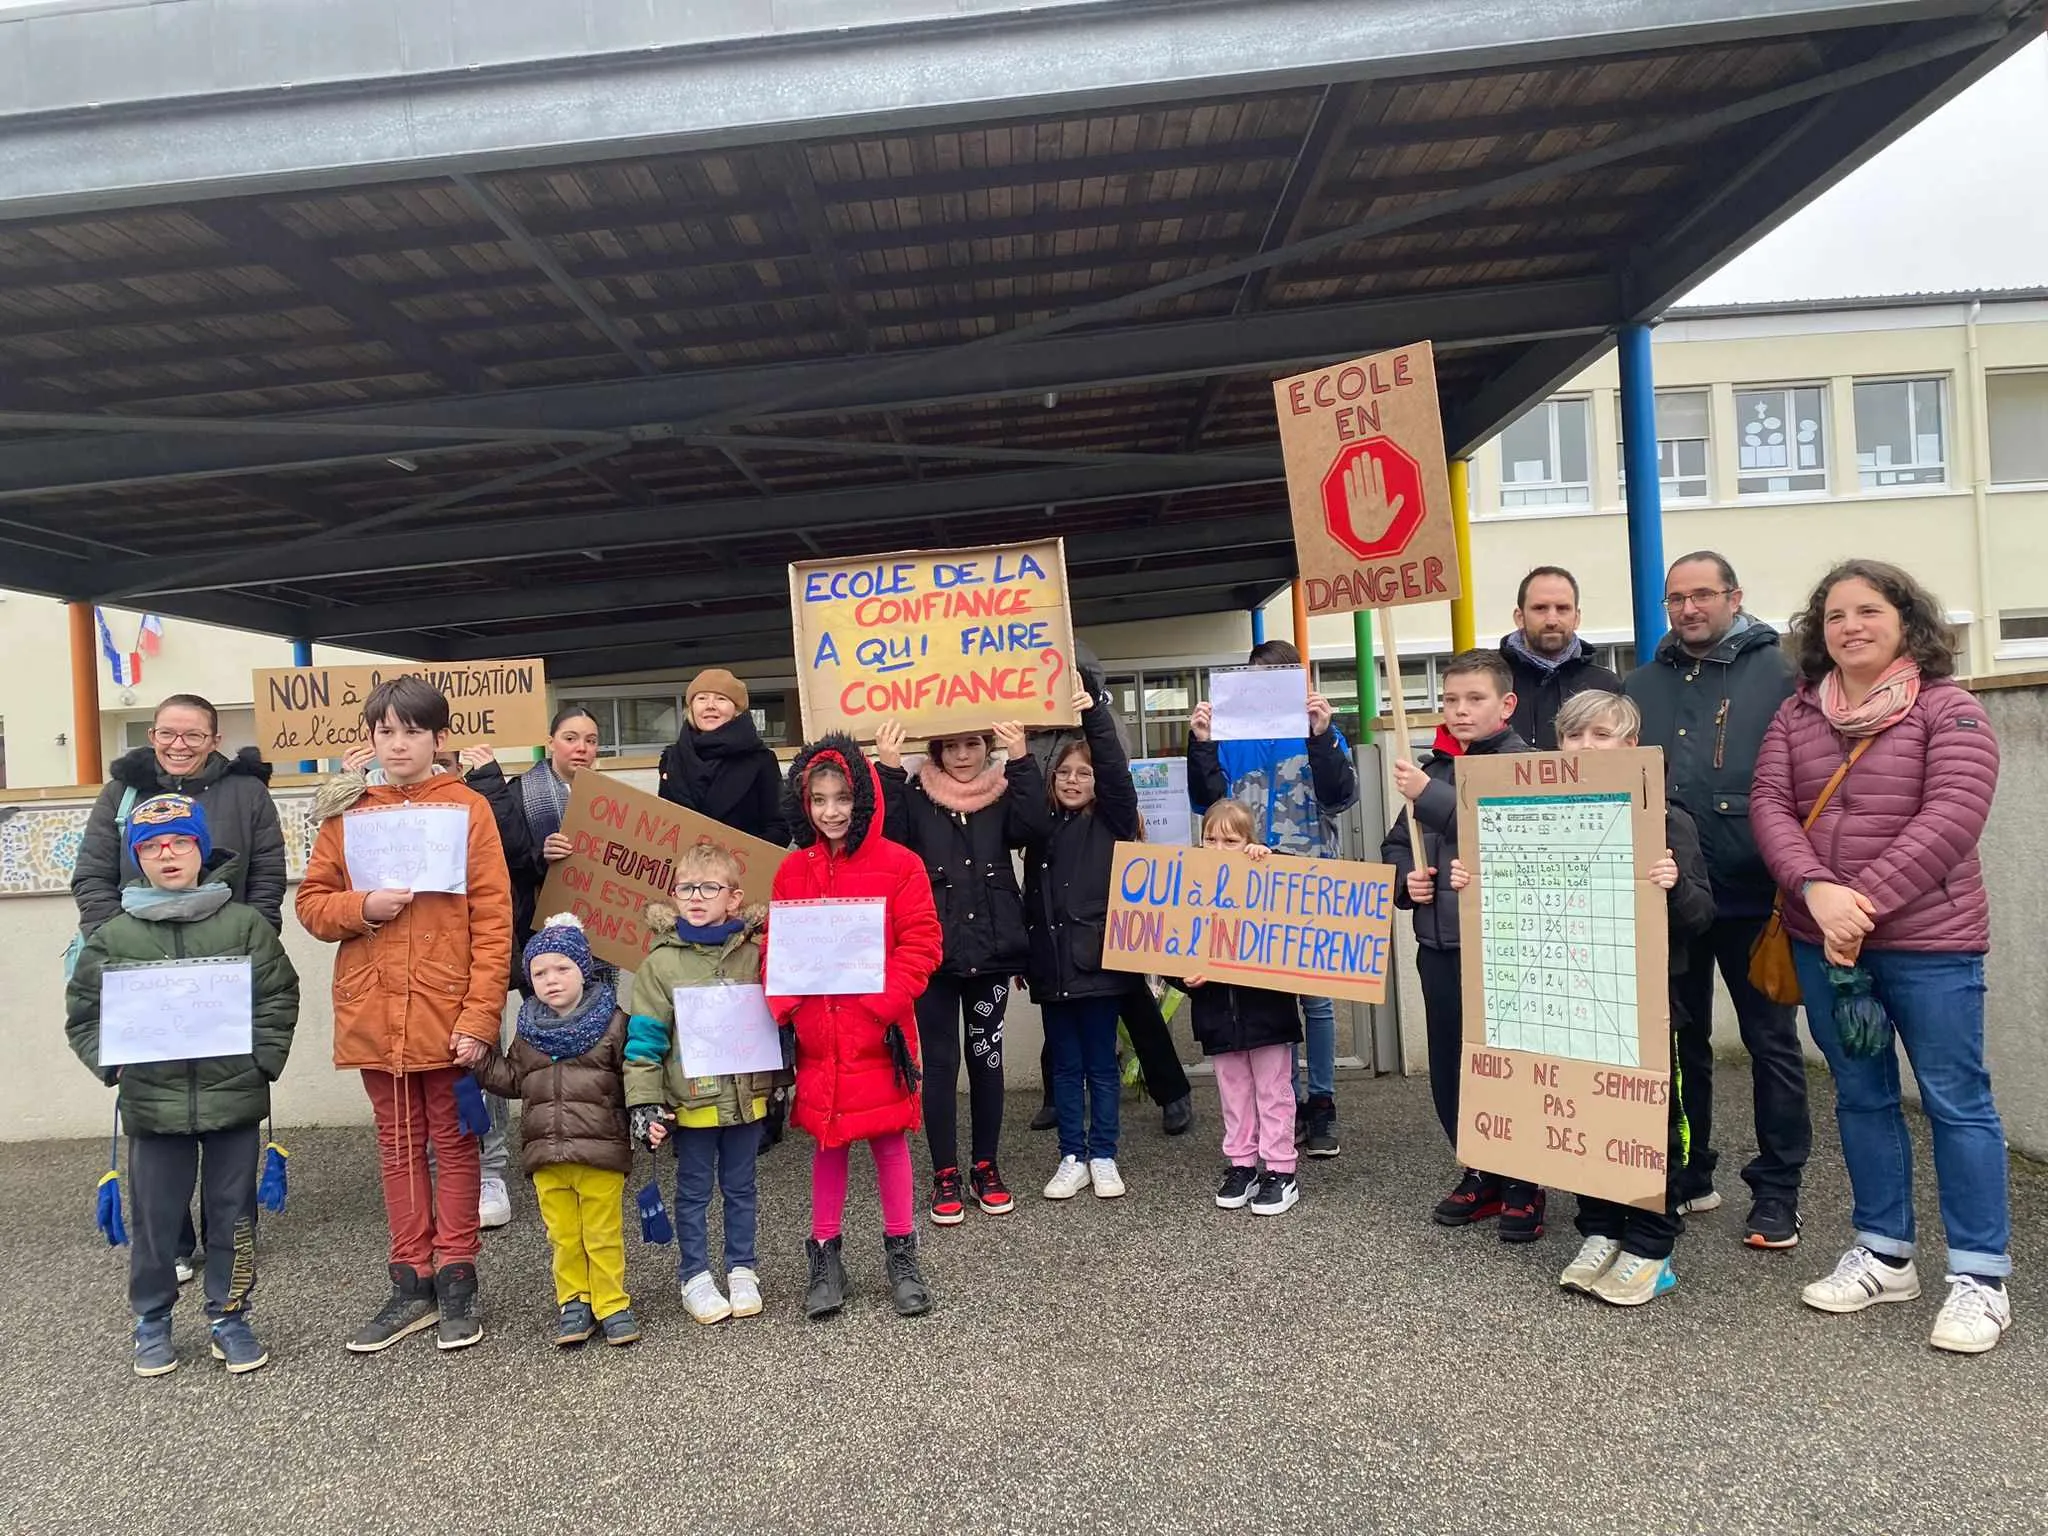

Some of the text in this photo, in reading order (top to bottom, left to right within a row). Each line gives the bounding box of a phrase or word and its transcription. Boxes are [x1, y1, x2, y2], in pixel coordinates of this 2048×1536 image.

[1288, 354, 1413, 416] ECOLE
[1335, 400, 1381, 441] EN
[804, 554, 1046, 602] ECOLE DE LA
[1306, 556, 1447, 611] DANGER
[854, 588, 1034, 627] CONFIANCE
[814, 622, 1053, 671] A QUI FAIRE
[269, 671, 330, 712] NON
[340, 681, 362, 706] à
[401, 665, 533, 698] IVATISATION
[272, 720, 300, 749] de
[304, 711, 369, 746] l'écol
[1515, 757, 1579, 786] NON
[589, 795, 681, 854] ON N'A
[572, 830, 604, 861] DE
[562, 866, 648, 912] ON EST
[1121, 851, 1389, 920] OUI à la DIFFÉRENCE
[1520, 894, 1533, 906] 18
[1545, 894, 1561, 907] 23
[571, 898, 638, 946] DANS
[1109, 909, 1165, 953] NON
[1165, 928, 1182, 956] à
[1520, 919, 1534, 932] 23
[1496, 946, 1517, 958] CE2
[1544, 947, 1563, 960] 26
[1487, 970, 1494, 982] 5
[1498, 970, 1517, 983] CM1
[1523, 972, 1537, 985] 18
[1546, 973, 1564, 992] 24
[1488, 997, 1494, 1010] 6
[1499, 999, 1519, 1013] CM2
[1523, 1001, 1537, 1013] 19
[1545, 1003, 1564, 1022] 24
[1471, 1053, 1514, 1080] NOUS
[1534, 1063, 1560, 1088] NE
[1544, 1094, 1576, 1119] PAS
[1475, 1111, 1513, 1141] QUE
[1546, 1126, 1587, 1157] DES
